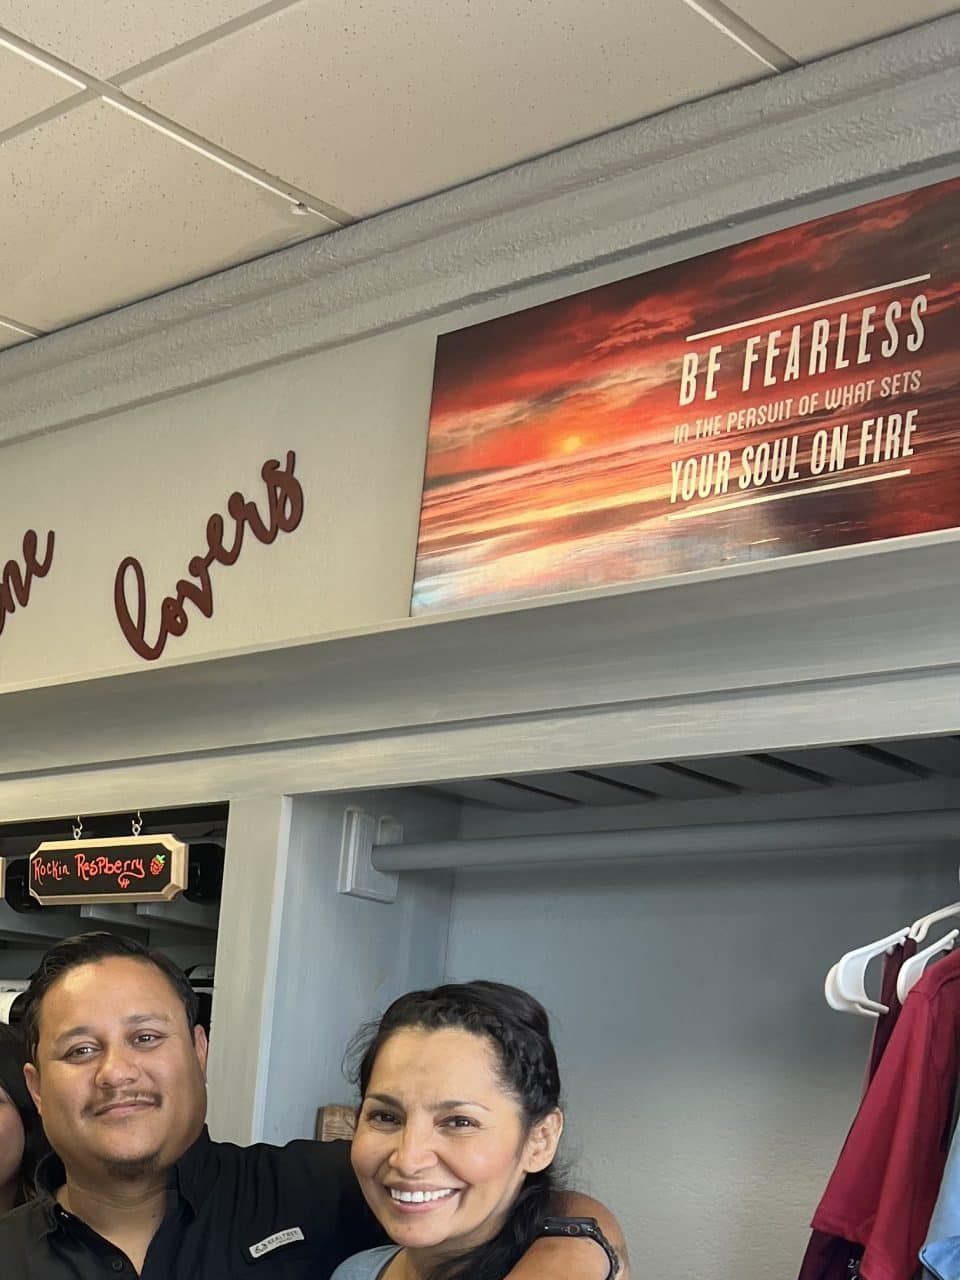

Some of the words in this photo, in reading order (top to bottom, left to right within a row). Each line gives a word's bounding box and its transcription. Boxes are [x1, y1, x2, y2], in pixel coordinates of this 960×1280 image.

[678, 345, 724, 407] BE
[742, 294, 928, 391] FEARLESS
[695, 415, 722, 439] THE
[727, 399, 793, 433] PERSUIT
[798, 393, 819, 415] OF
[824, 380, 875, 410] WHAT
[879, 370, 922, 398] SETS
[670, 450, 731, 503] YOUR
[738, 435, 800, 490] SOUL
[810, 424, 850, 475] ON
[858, 409, 919, 466] FIRE
